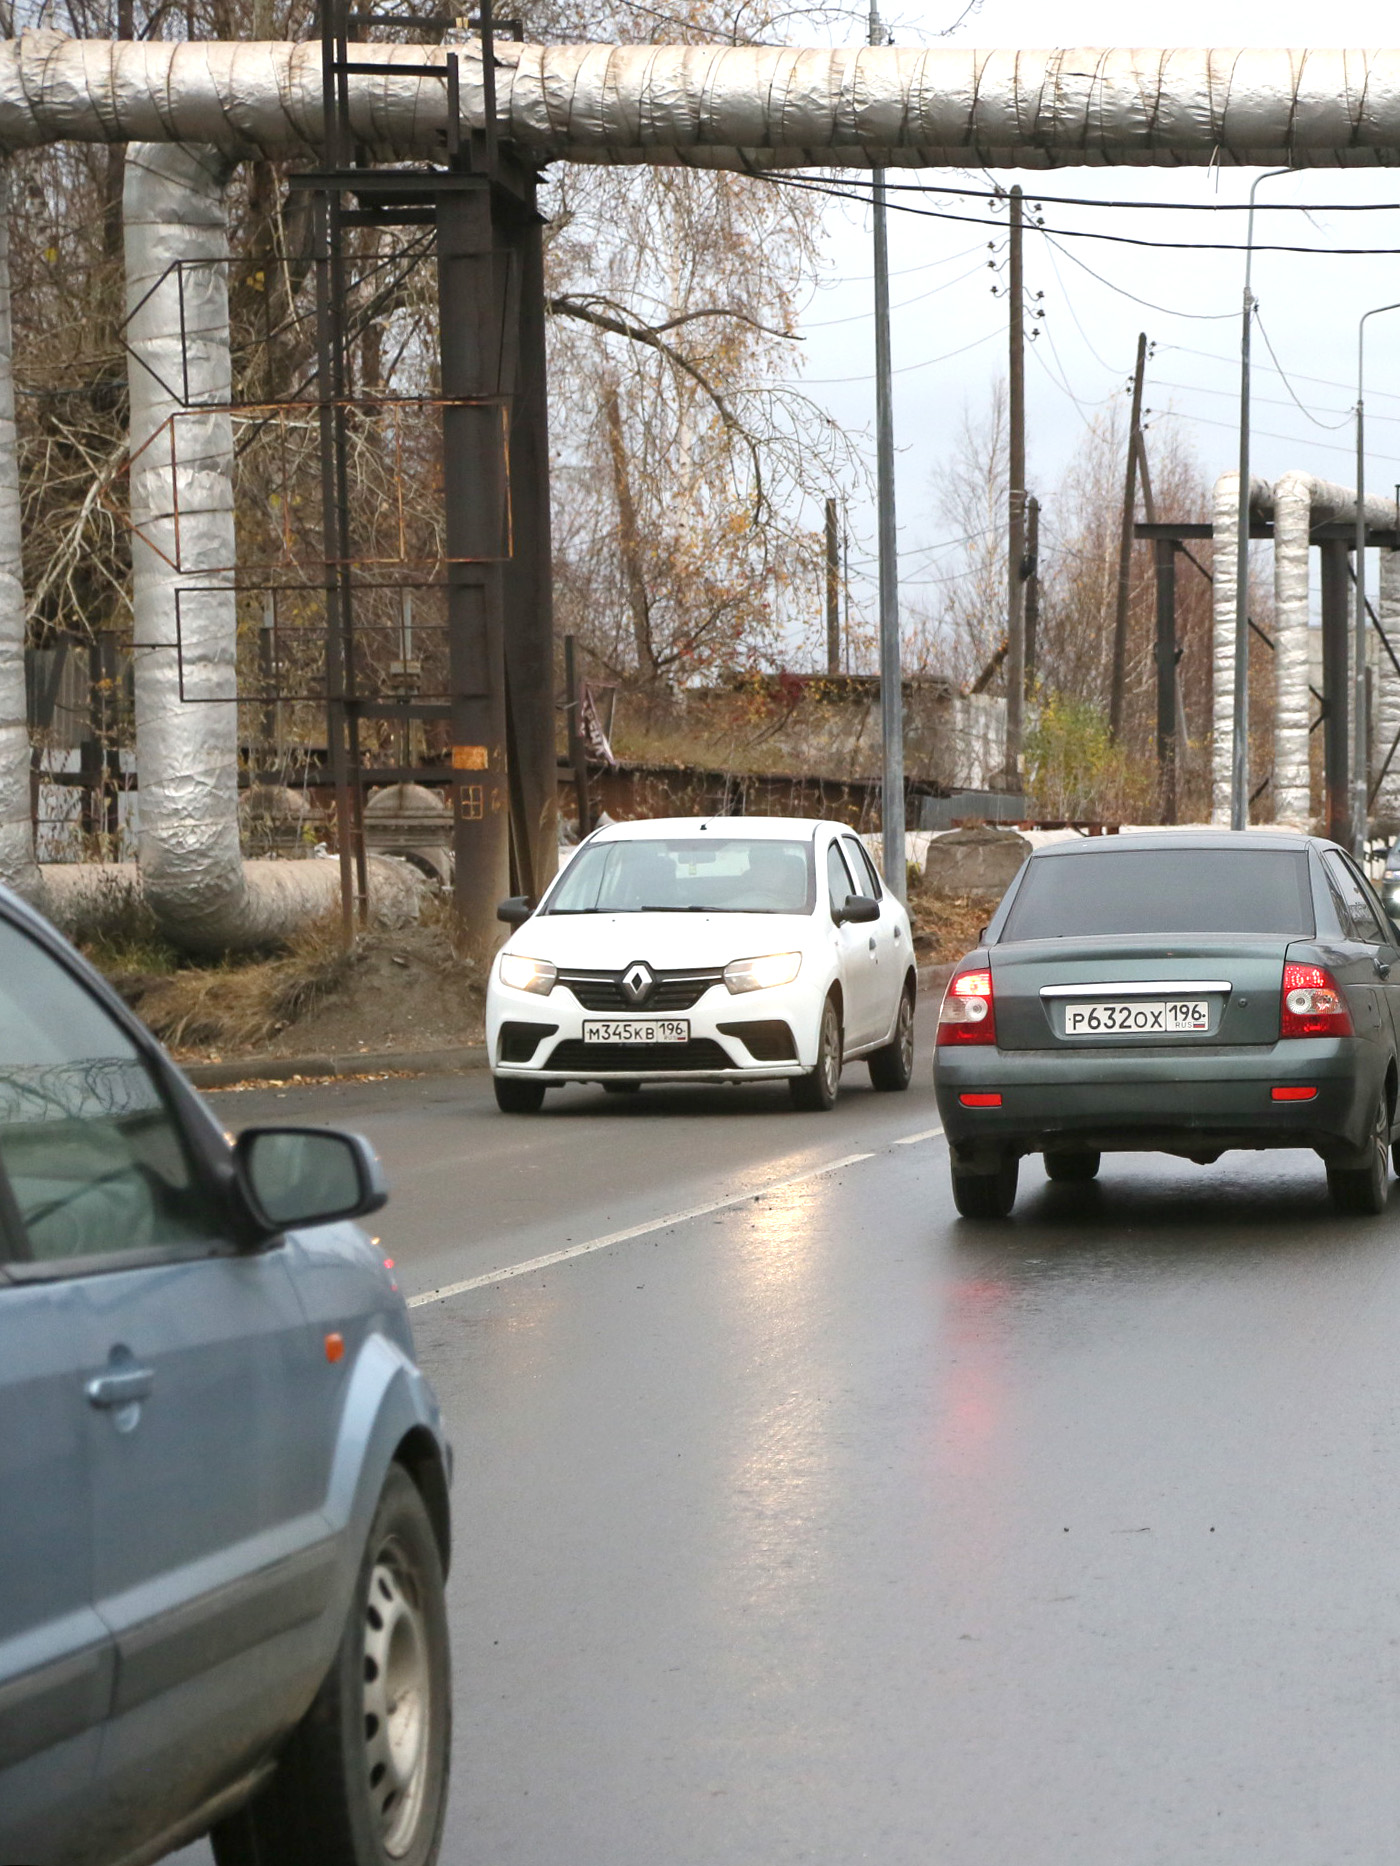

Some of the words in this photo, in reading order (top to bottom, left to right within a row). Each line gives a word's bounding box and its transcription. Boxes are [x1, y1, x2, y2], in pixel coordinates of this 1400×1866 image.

[1072, 1006, 1163, 1031] Р632ОХ
[1168, 1004, 1202, 1022] 196
[1175, 1021, 1192, 1029] RUS
[588, 1024, 655, 1041] М345КВ
[658, 1022, 683, 1036] 196
